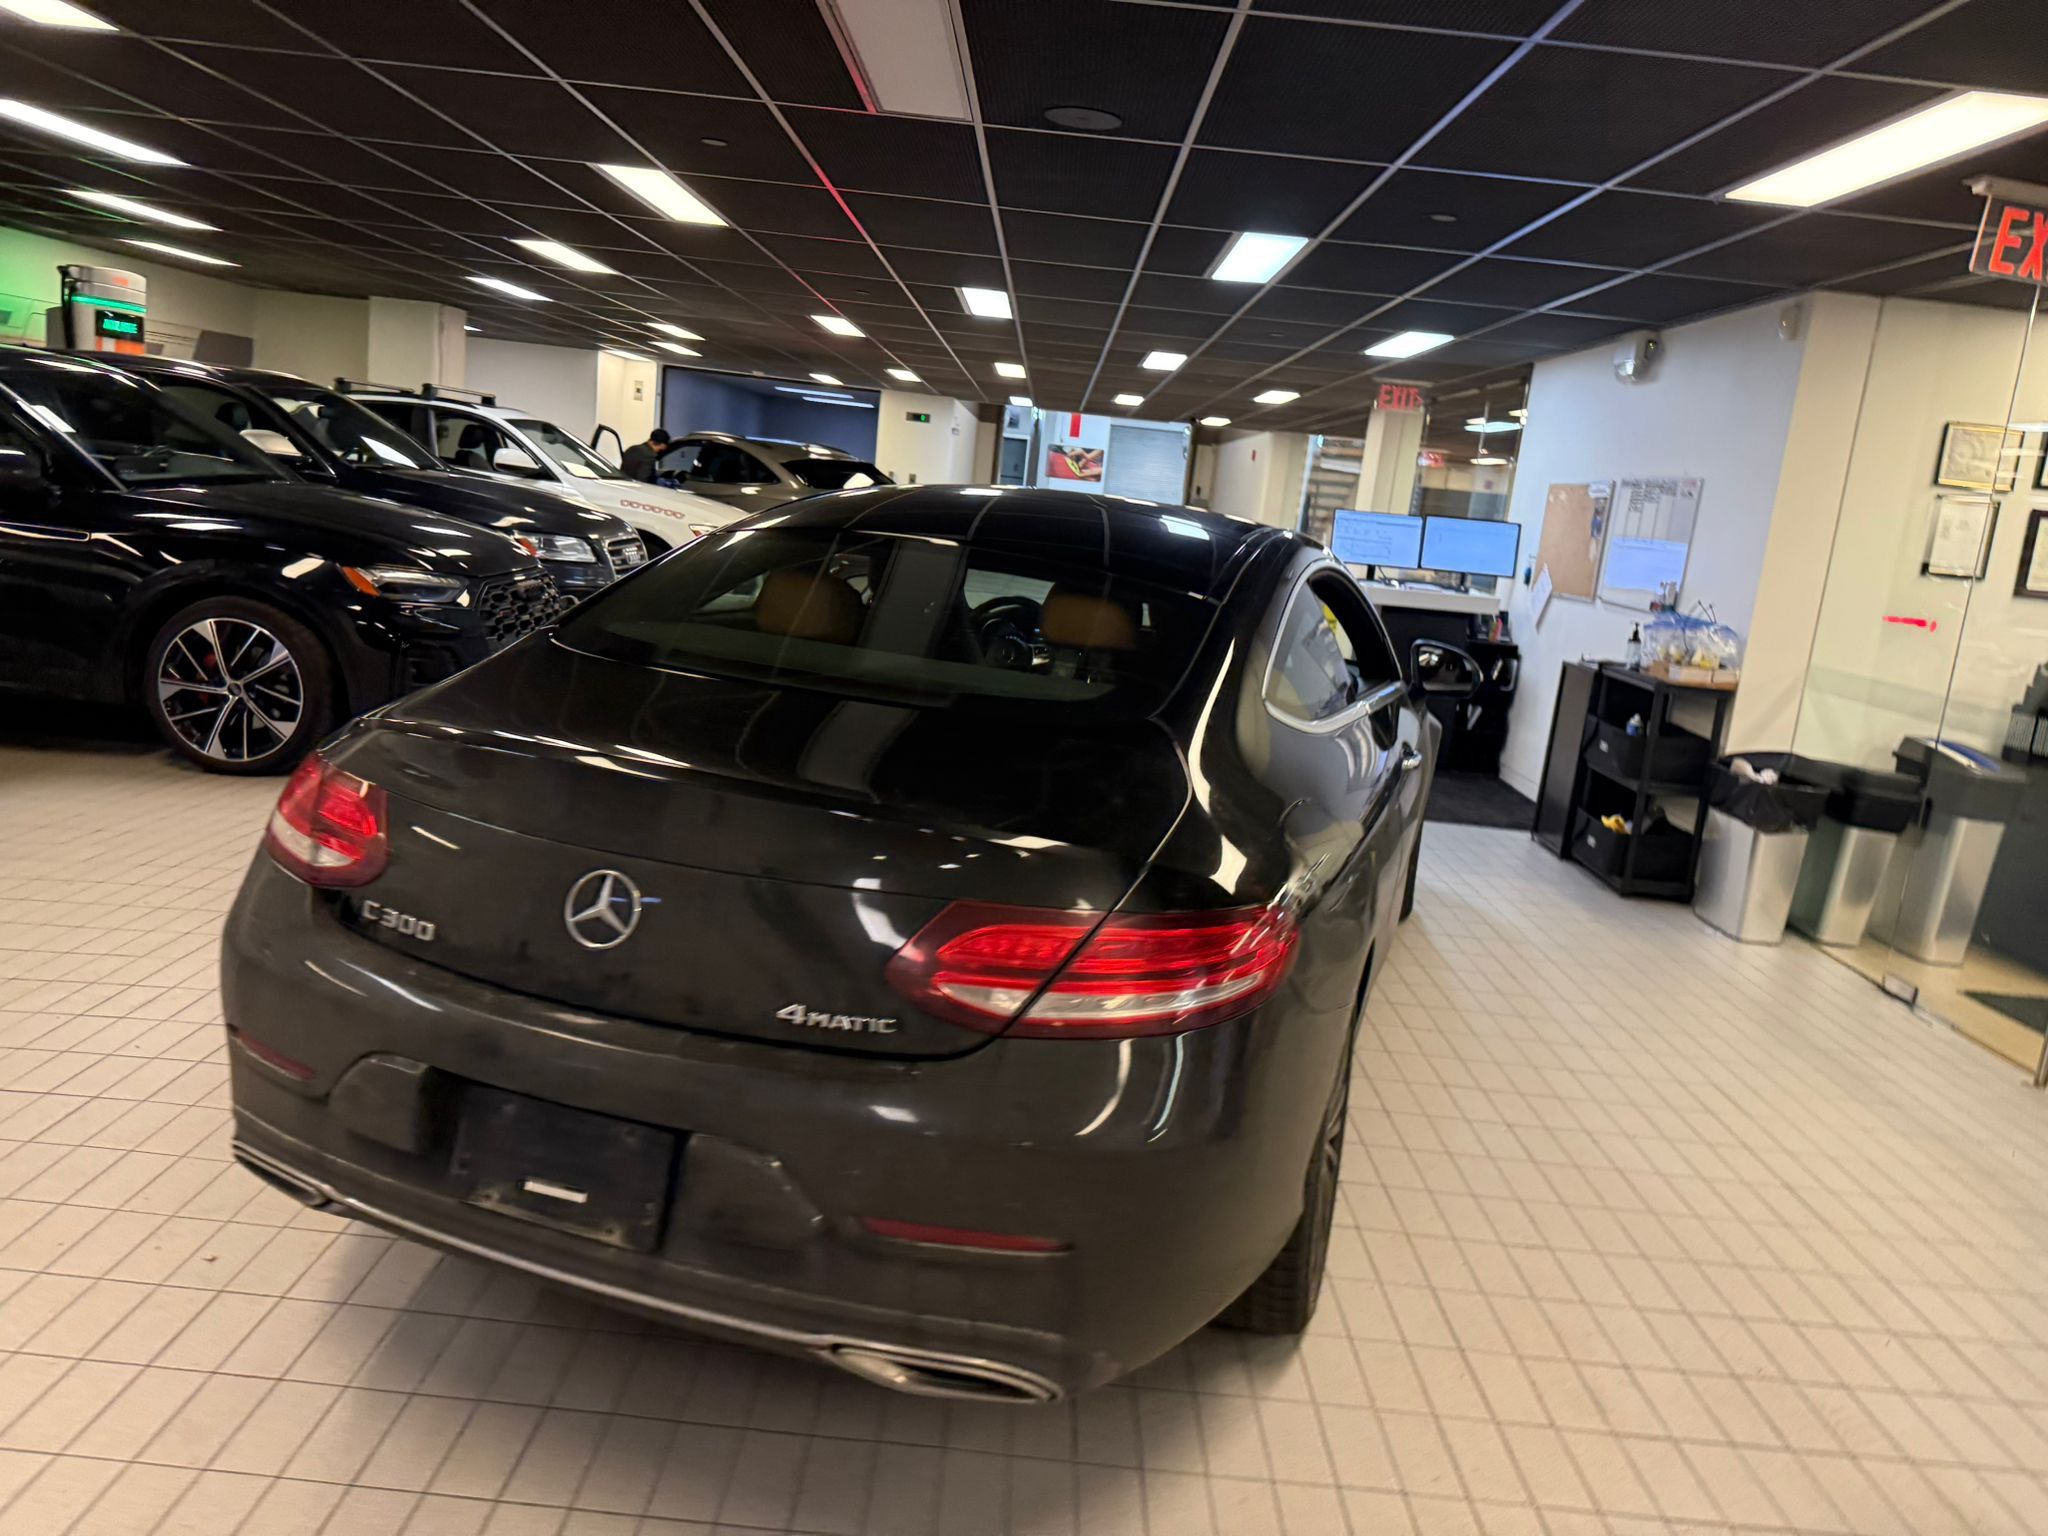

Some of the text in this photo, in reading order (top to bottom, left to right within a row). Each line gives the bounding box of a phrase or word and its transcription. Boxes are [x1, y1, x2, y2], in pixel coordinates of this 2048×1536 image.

[1989, 206, 2048, 281] EX
[1379, 384, 1420, 411] EXIT
[362, 900, 436, 941] C300
[775, 1003, 898, 1034] 4MATIC
